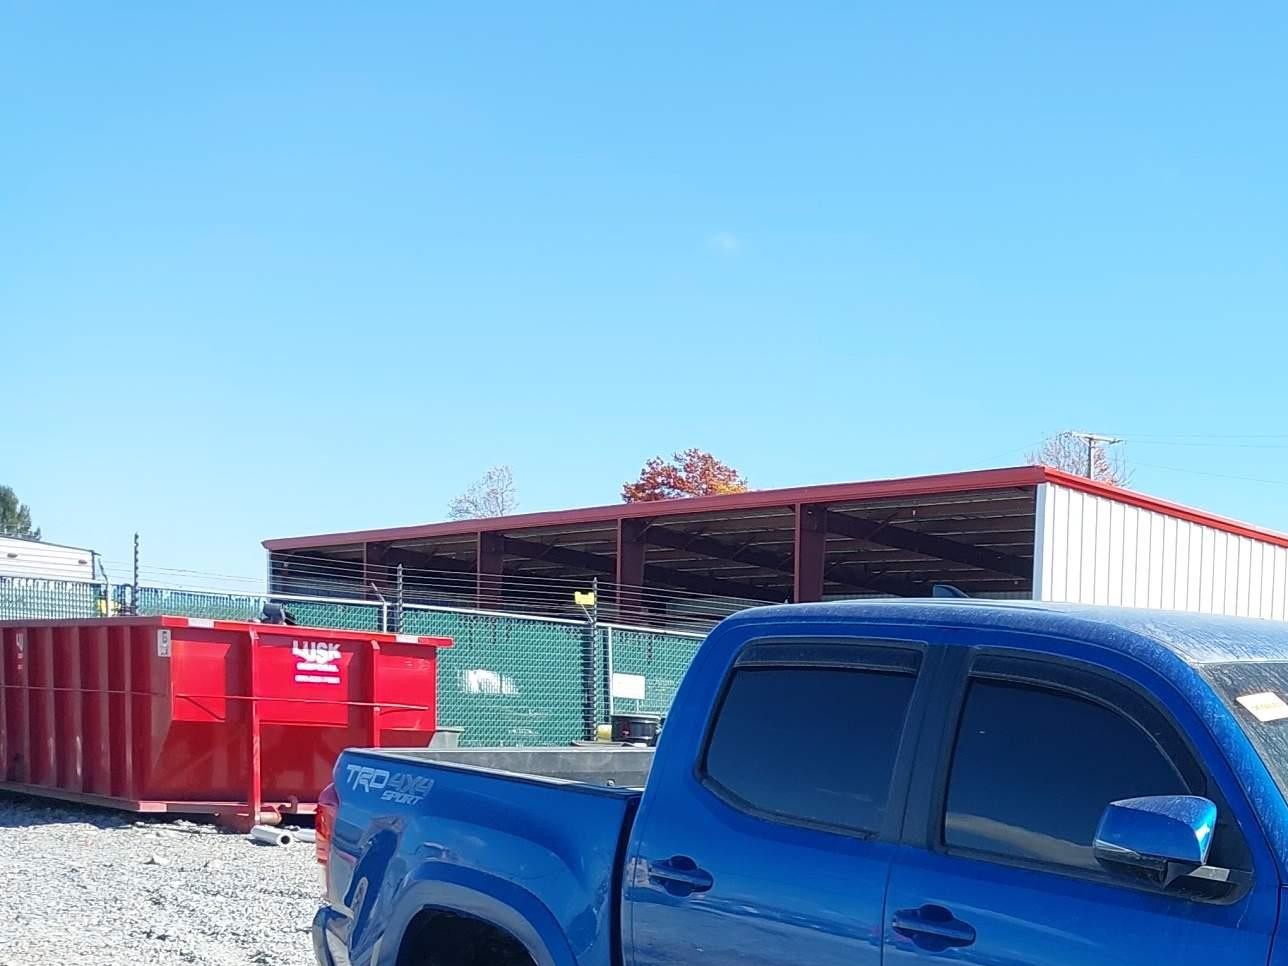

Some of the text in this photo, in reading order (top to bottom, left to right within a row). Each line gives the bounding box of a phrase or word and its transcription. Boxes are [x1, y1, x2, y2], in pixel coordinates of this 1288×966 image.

[292, 639, 342, 664] LUSK
[346, 764, 390, 792] TRD
[380, 789, 424, 806] SPORT
